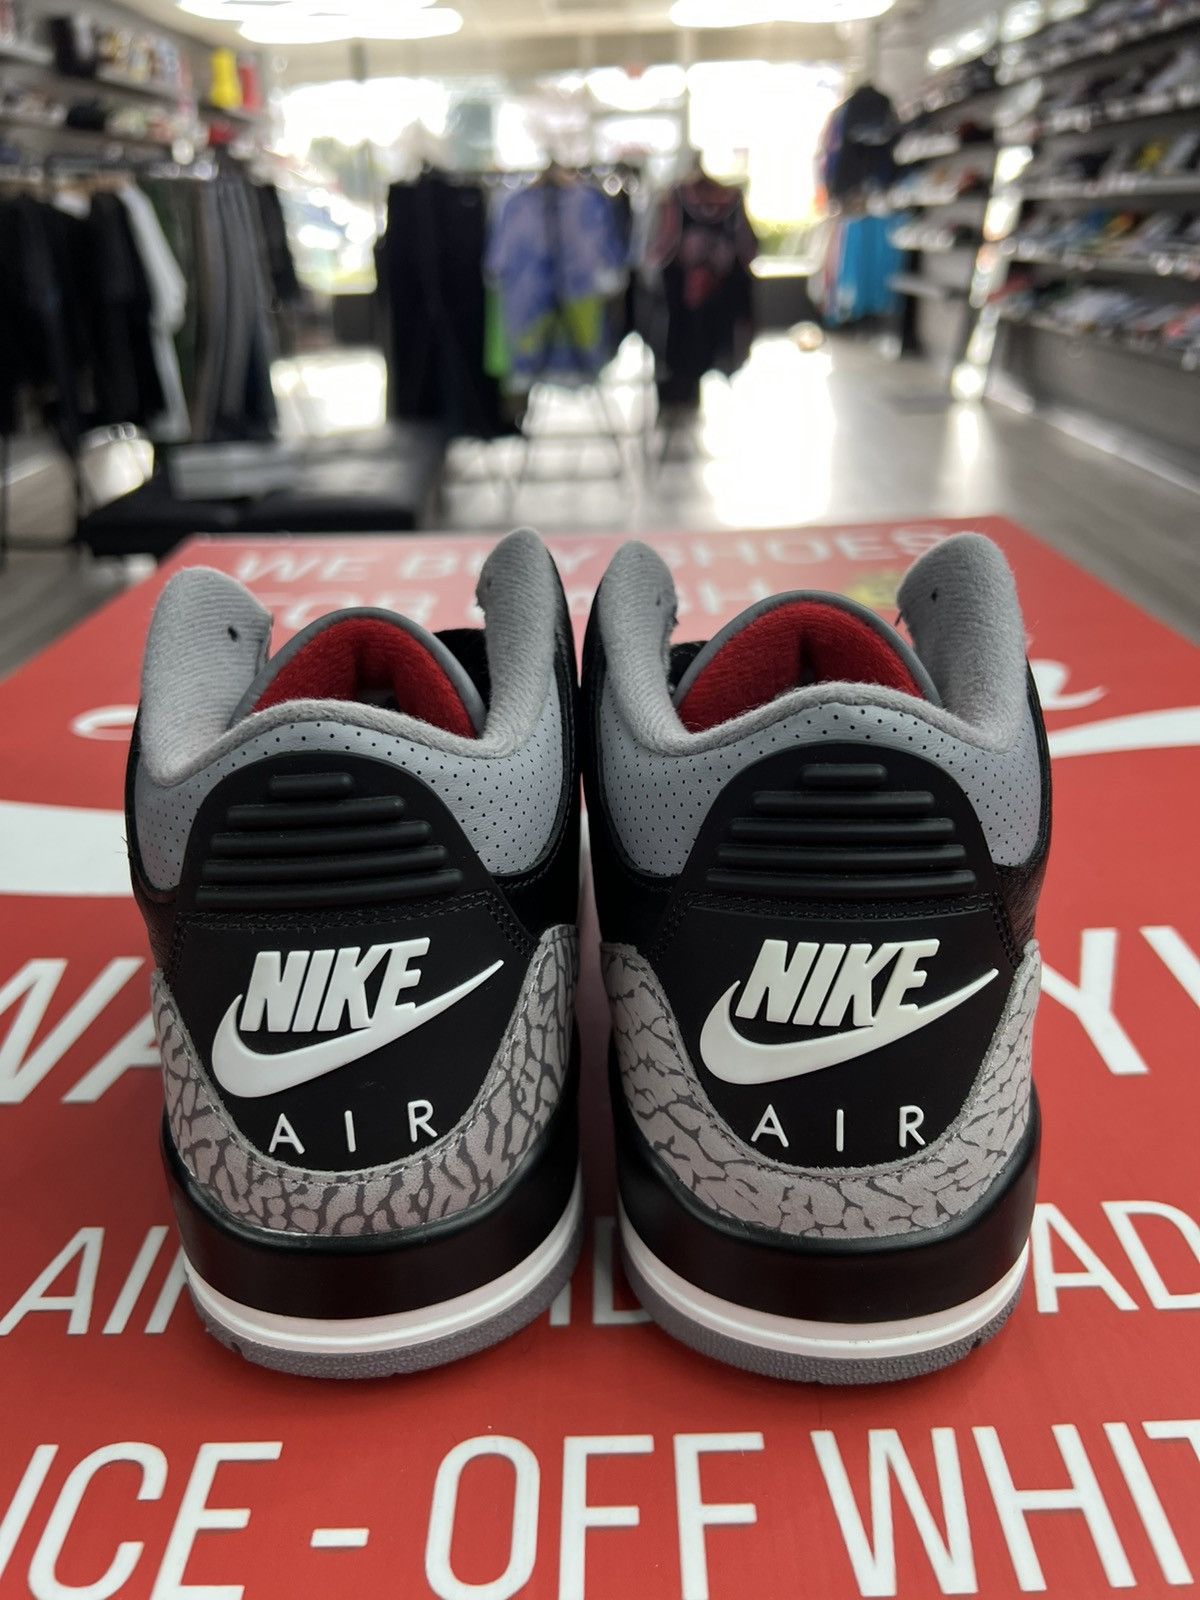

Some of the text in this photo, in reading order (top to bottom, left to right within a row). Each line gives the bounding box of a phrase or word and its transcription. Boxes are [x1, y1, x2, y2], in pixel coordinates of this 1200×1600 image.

[236, 549, 370, 582] WE
[240, 938, 430, 1033] NIKE
[735, 939, 940, 1027] NIKE
[268, 1099, 438, 1154] AIR
[751, 1104, 925, 1152] AIR
[425, 1432, 764, 1600] OFF
